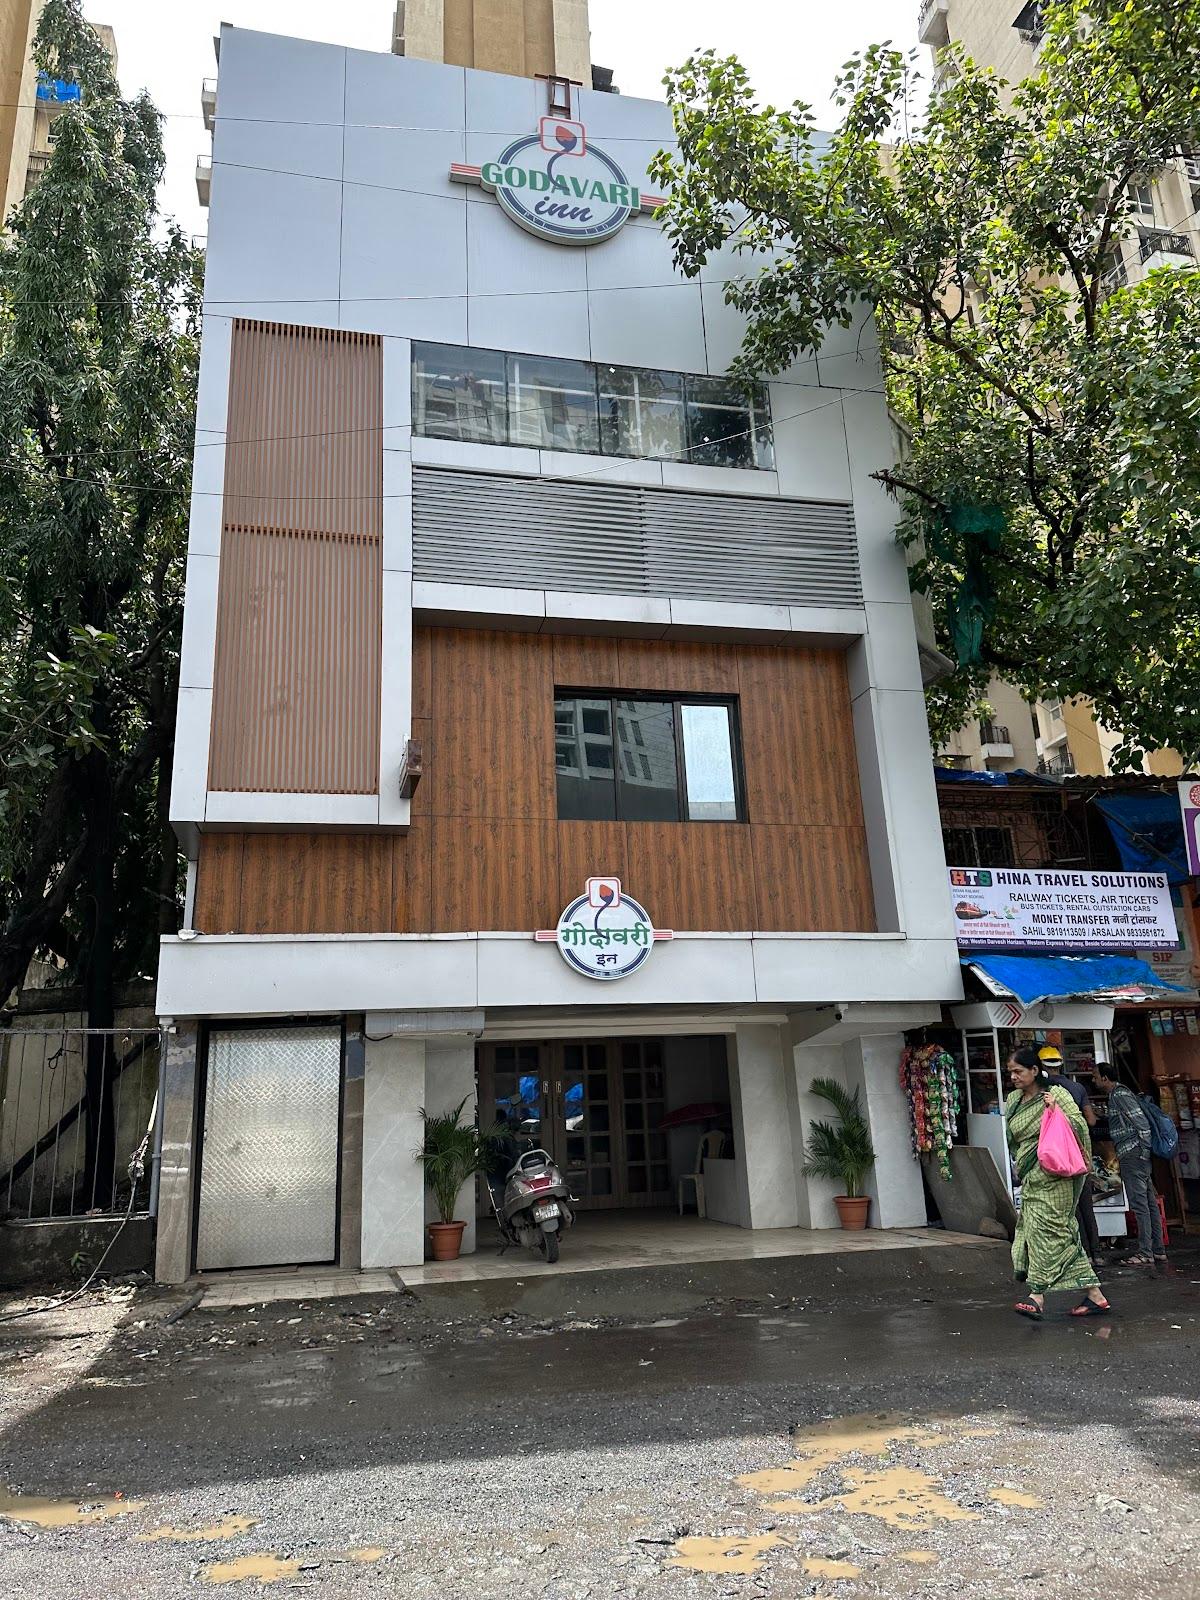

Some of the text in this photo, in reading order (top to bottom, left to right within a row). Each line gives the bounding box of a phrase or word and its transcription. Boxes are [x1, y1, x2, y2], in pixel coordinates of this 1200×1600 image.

[481, 162, 640, 208] GODAVARI
[535, 196, 593, 221] inn
[951, 870, 991, 886] HTS
[996, 872, 1165, 888] HINA TRAVEL SOLUTIONS
[1009, 893, 1159, 905] RAILWAY TICKETS, AIR TICKETS
[1032, 914, 1063, 924] MONEY
[1065, 915, 1110, 925] TRANSFER
[1112, 913, 1129, 924] मनी
[561, 922, 650, 949] गोदावरी
[1022, 926, 1046, 935] SAHIL
[1092, 928, 1126, 937] ARSALAN
[596, 954, 618, 967] इन
[1152, 952, 1173, 962] SIP
